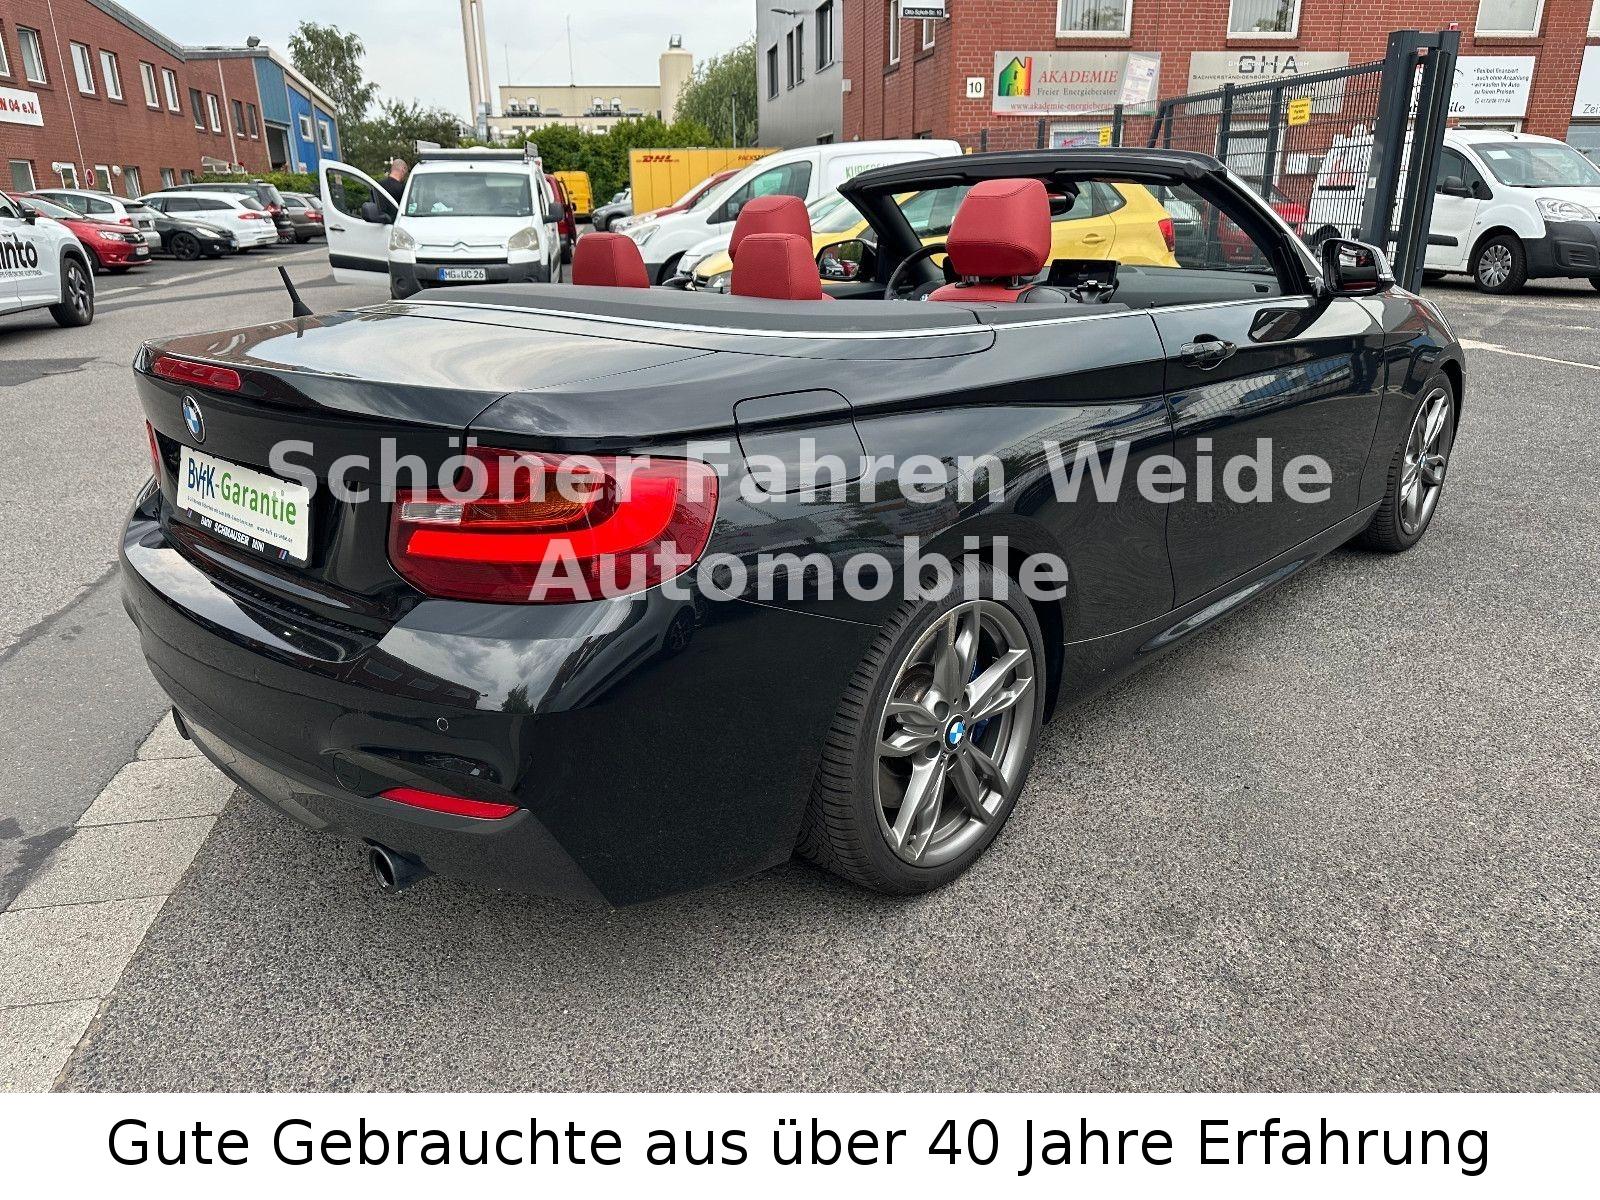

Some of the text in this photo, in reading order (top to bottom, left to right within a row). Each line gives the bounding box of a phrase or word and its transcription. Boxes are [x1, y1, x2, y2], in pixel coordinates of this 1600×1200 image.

[1238, 55, 1299, 74] GHA
[1038, 70, 1119, 83] AKADEMIE
[968, 81, 982, 93] 10
[1037, 87, 1059, 96] Freier
[1063, 87, 1118, 97] Energieberater
[642, 154, 675, 163] DHL
[444, 270, 484, 279] MG UC 26
